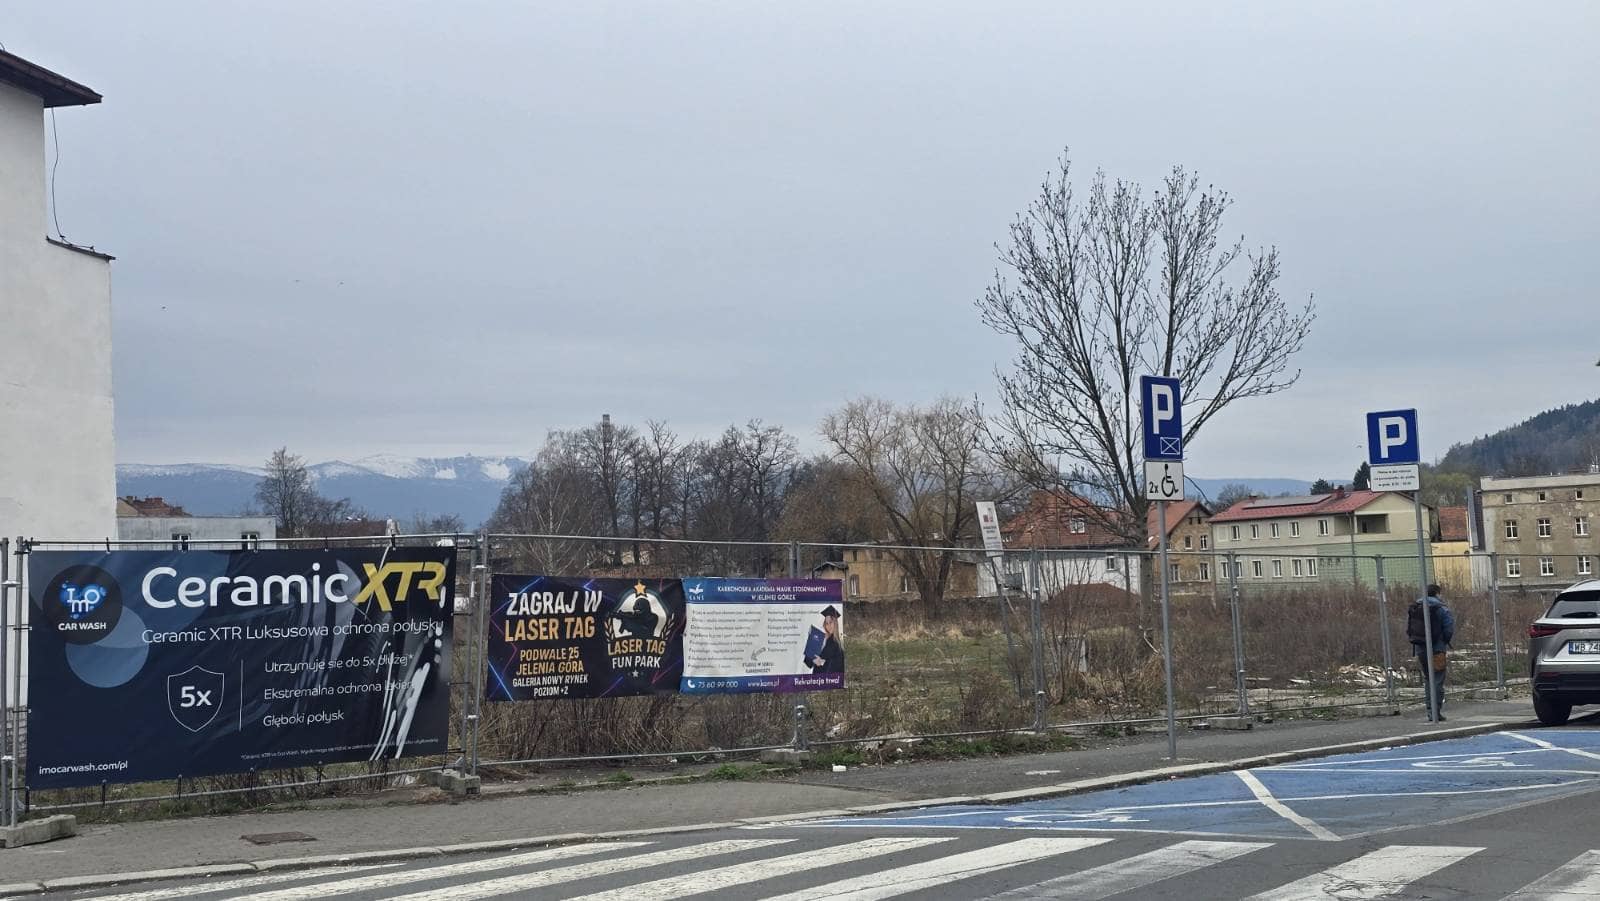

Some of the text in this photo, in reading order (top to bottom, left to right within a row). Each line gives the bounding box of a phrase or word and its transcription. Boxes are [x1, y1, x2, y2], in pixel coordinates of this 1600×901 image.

[1151, 384, 1174, 435] P
[1378, 416, 1408, 459] P
[1149, 481, 1159, 494] 2x
[141, 561, 446, 611] Ceramic XTR
[506, 590, 603, 616] ZAGRAJ W
[58, 622, 106, 631] CAR WASH
[142, 627, 207, 643] Ceramic
[209, 626, 242, 641] XTR
[246, 624, 329, 640] Luksusowa
[333, 620, 390, 636] ochrona
[505, 616, 595, 642] LASER TAG
[520, 646, 580, 662] PODWALE 25
[607, 638, 666, 656] LASER TAG
[265, 659, 325, 674] Utrzymuje
[345, 657, 360, 668] do
[362, 656, 376, 667] 5x
[516, 662, 555, 676] JELENIA
[612, 655, 661, 669] FUN PARK
[512, 673, 589, 688] GALERIA NOWY RYNEK
[726, 680, 739, 688] 000
[180, 685, 212, 708] 5x
[264, 685, 334, 700] Ekstremalna
[337, 682, 382, 695] ochrona
[533, 686, 560, 697] POZIOM
[263, 709, 345, 728] Głęboki połysk
[39, 760, 128, 775] imocarwash.com/pl
